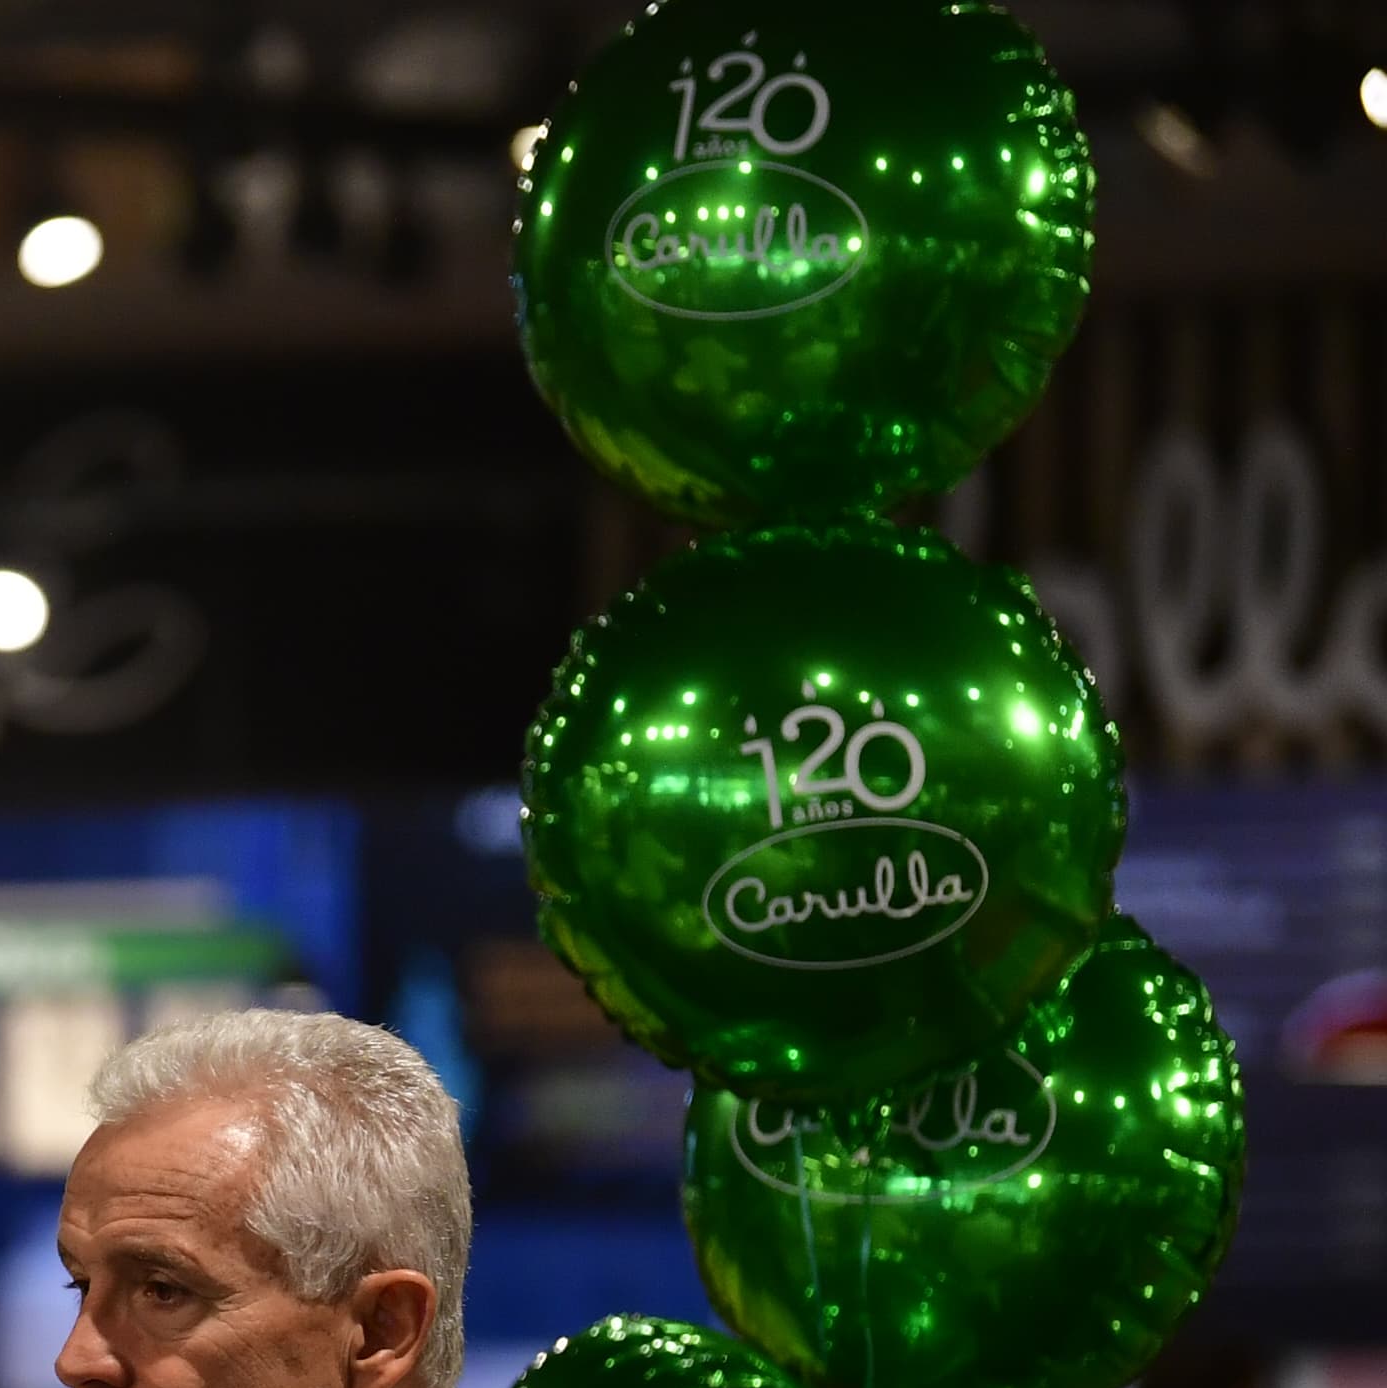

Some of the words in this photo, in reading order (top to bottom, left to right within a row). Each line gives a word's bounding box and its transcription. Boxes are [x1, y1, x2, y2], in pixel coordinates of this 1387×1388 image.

[668, 50, 831, 162] 120
[623, 203, 847, 274] Carulla
[740, 704, 927, 829] 120
[791, 797, 855, 825] años
[725, 850, 974, 933] Carulla
